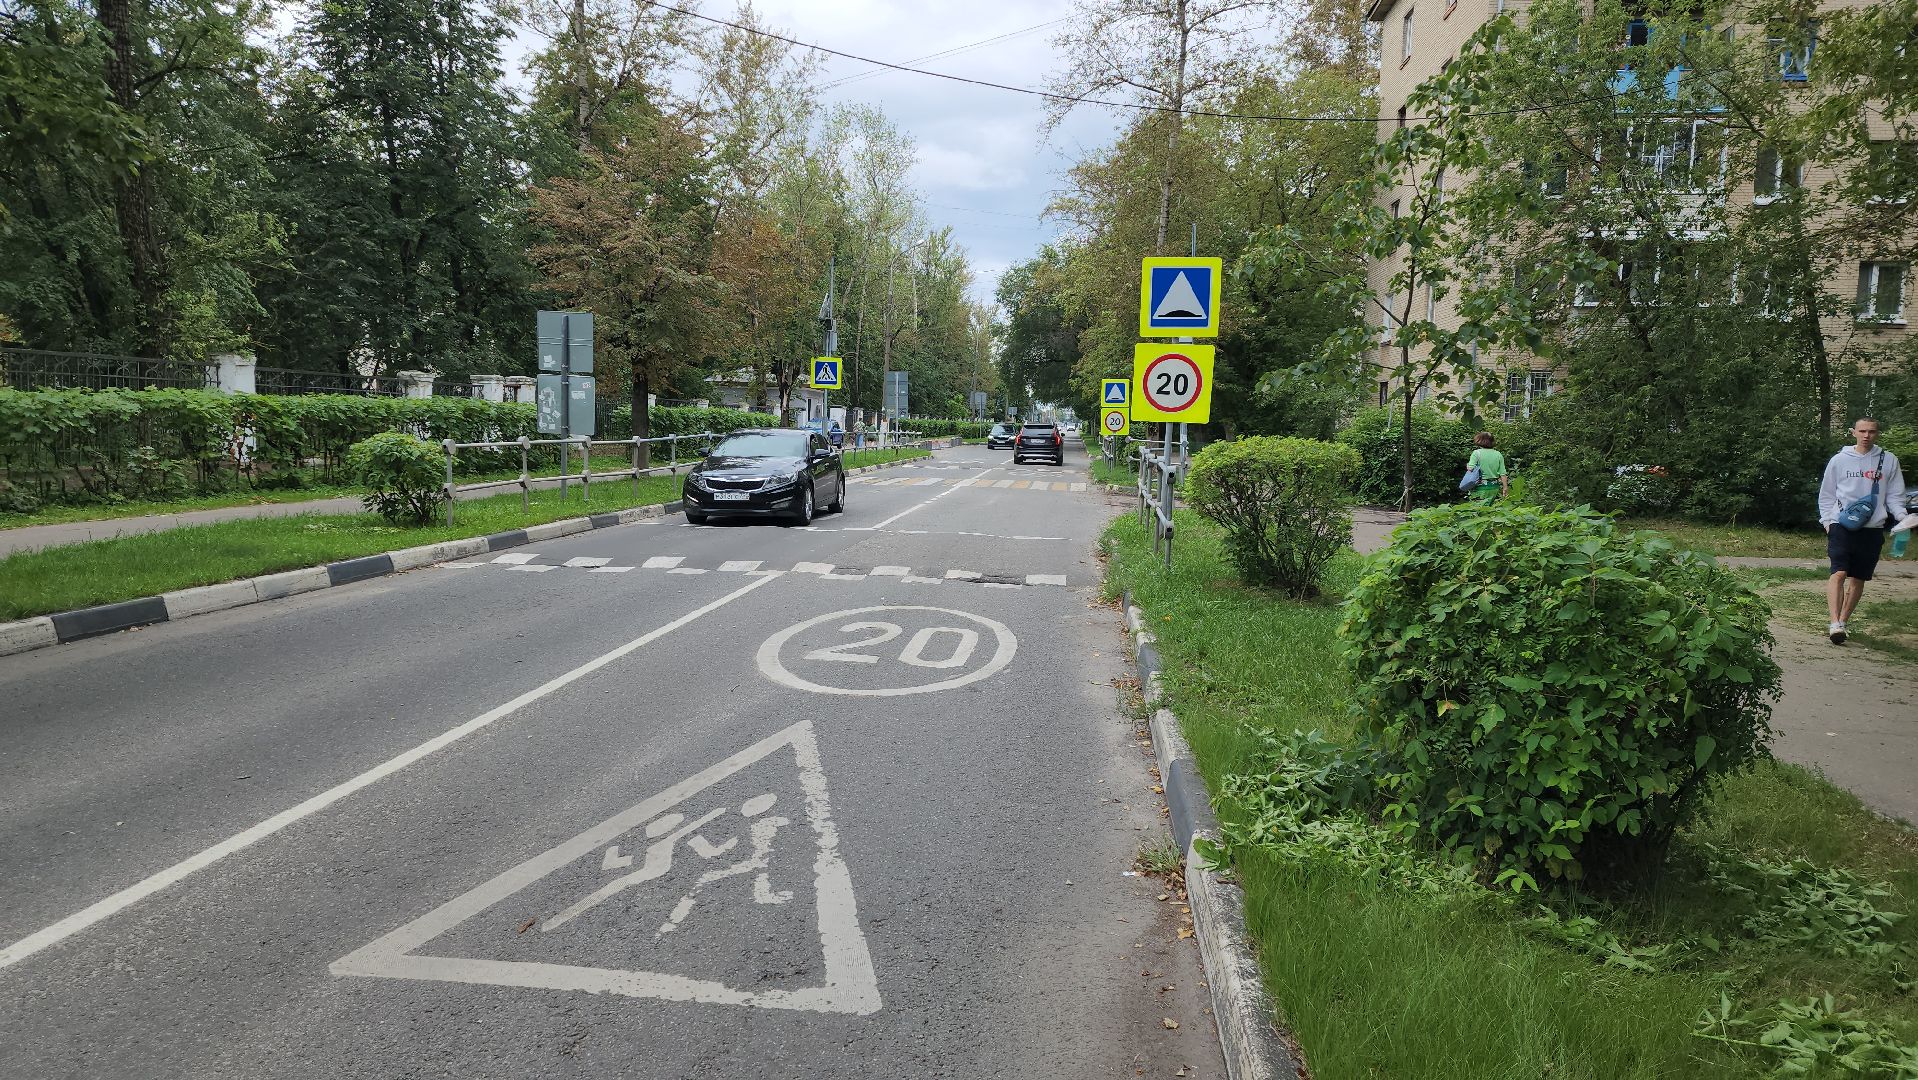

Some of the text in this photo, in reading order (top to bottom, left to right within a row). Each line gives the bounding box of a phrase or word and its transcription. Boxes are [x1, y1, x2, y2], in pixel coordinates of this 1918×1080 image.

[1156, 372, 1189, 396] 20
[1110, 417, 1121, 426] 20
[803, 621, 979, 669] 20
